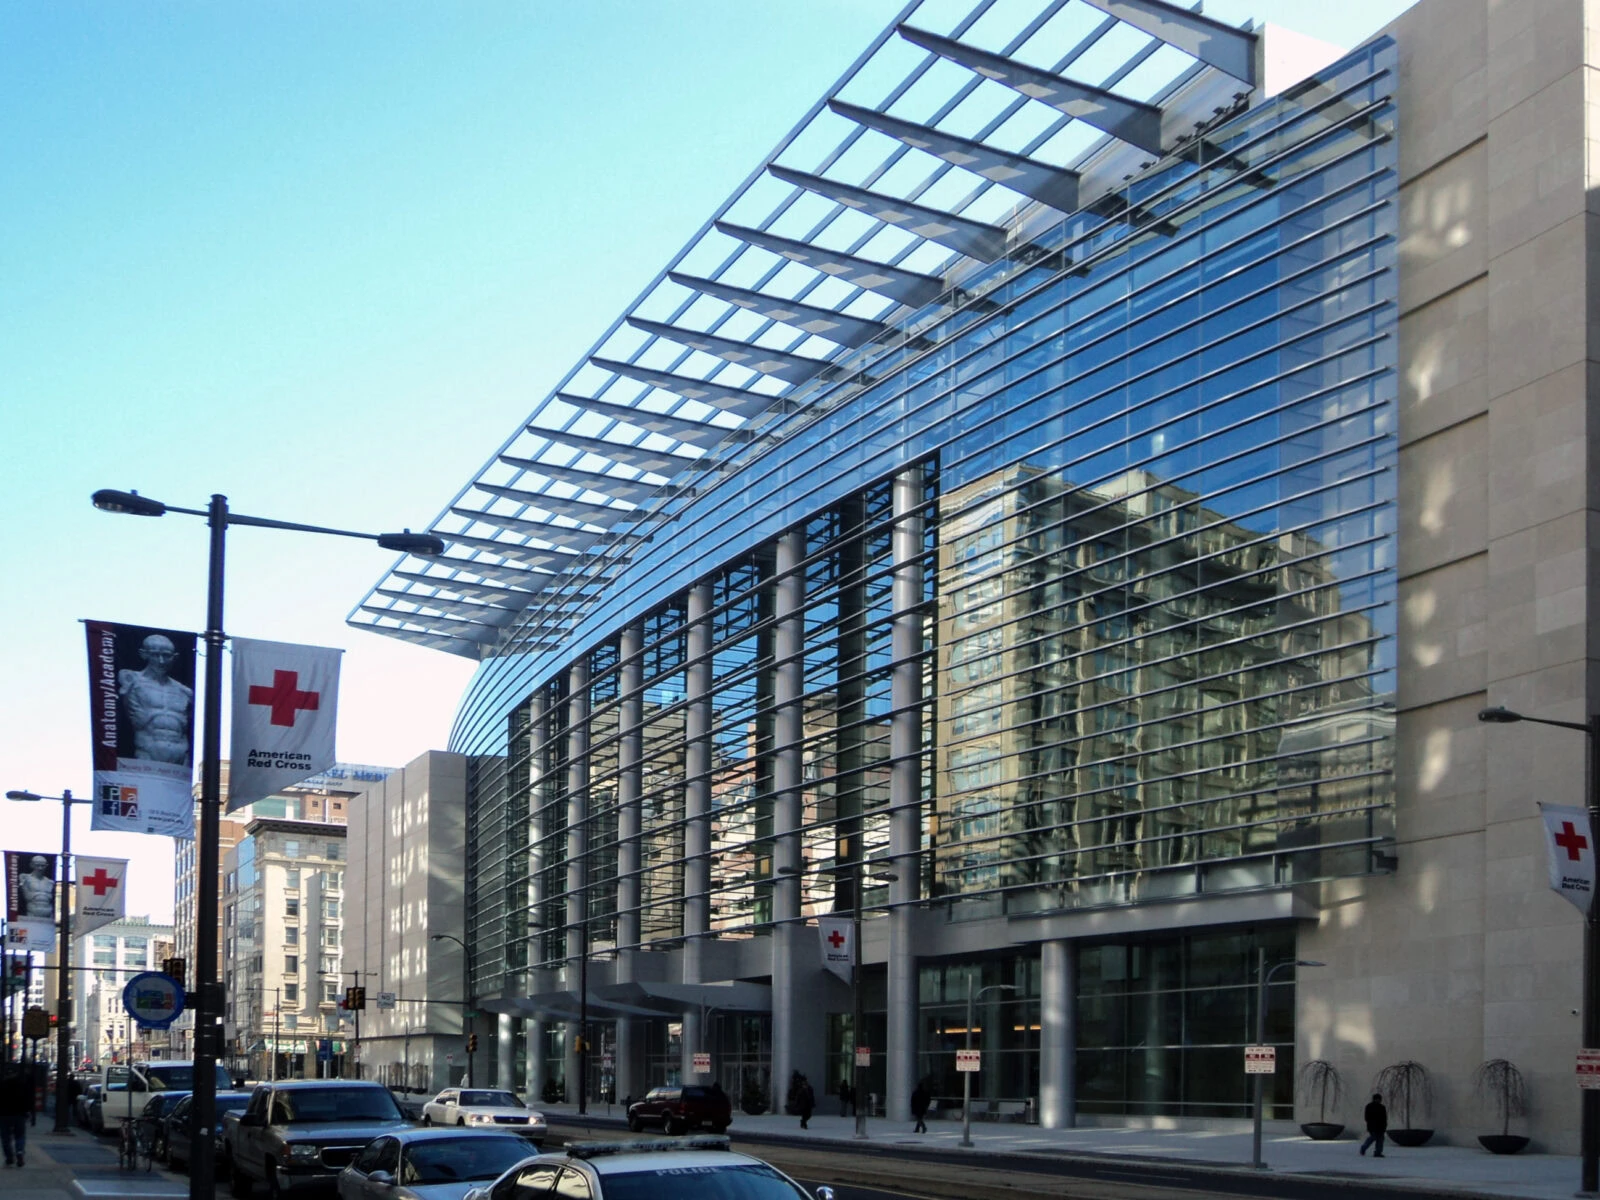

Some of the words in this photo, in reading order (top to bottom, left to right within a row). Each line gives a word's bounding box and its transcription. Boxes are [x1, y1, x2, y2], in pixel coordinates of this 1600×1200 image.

[99, 630, 119, 747] Anatomy/Academy
[248, 749, 311, 760] American
[247, 758, 272, 769] Red
[275, 760, 312, 771] Cross
[656, 1167, 724, 1177] POLICE
